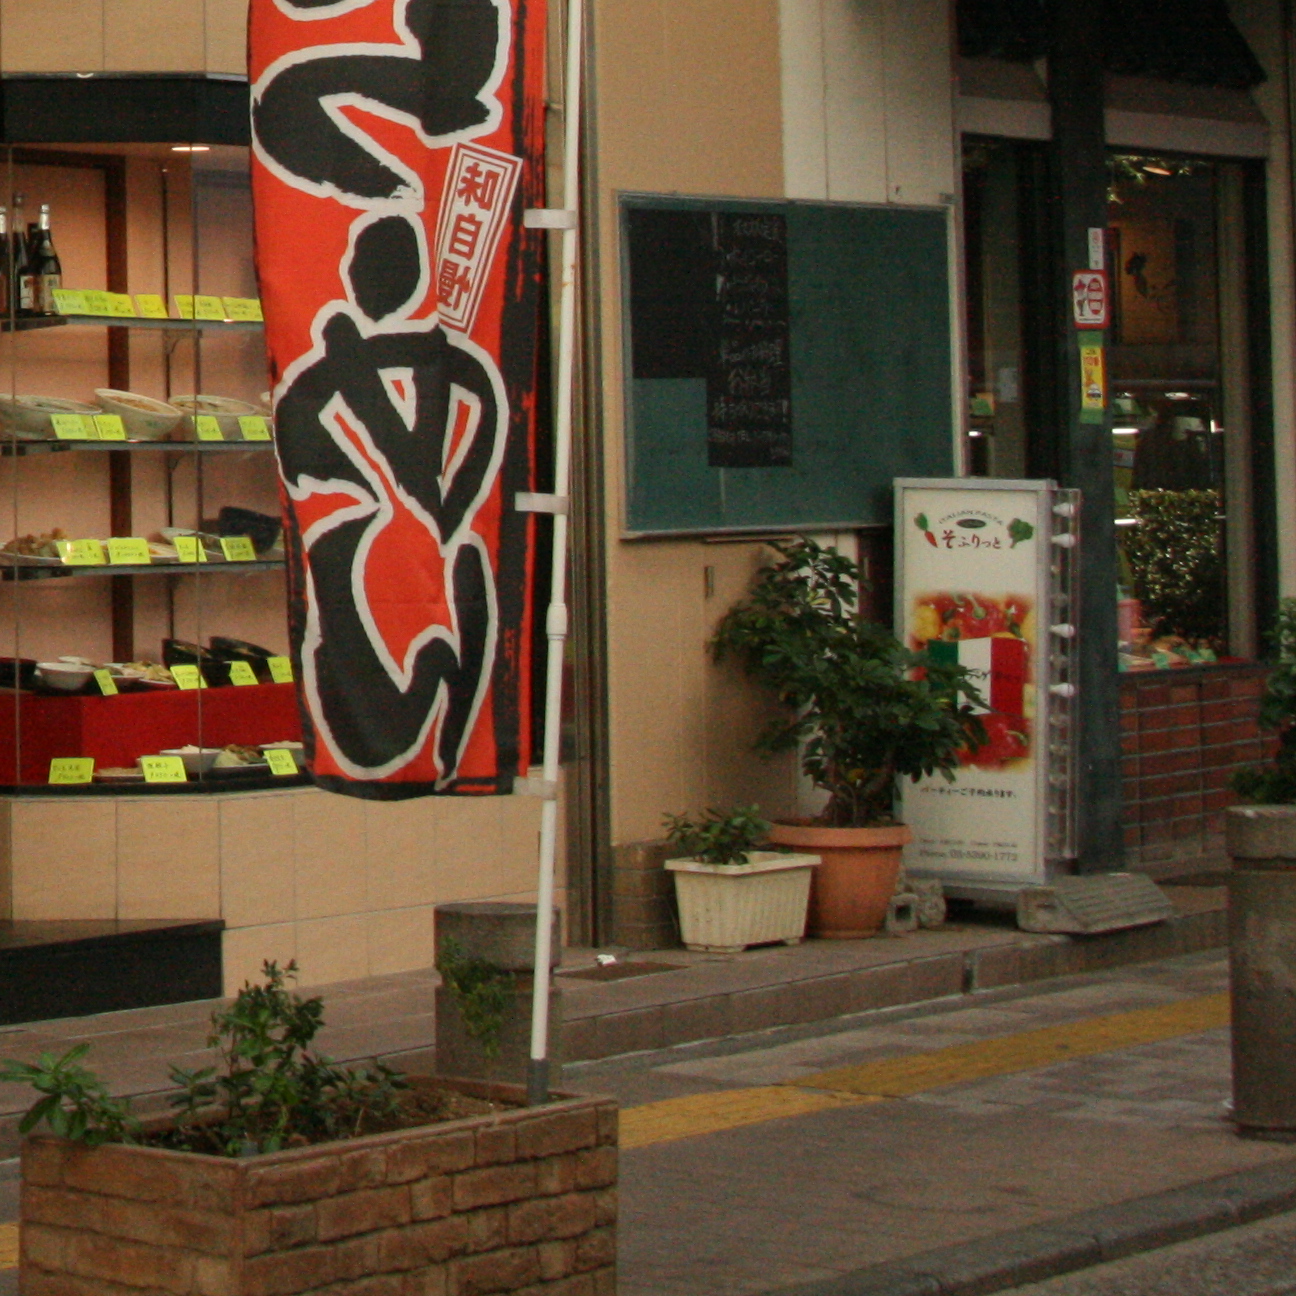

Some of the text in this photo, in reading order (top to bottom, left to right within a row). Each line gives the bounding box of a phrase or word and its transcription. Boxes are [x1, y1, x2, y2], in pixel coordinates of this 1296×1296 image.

[941, 529, 1002, 549] そふりっと
